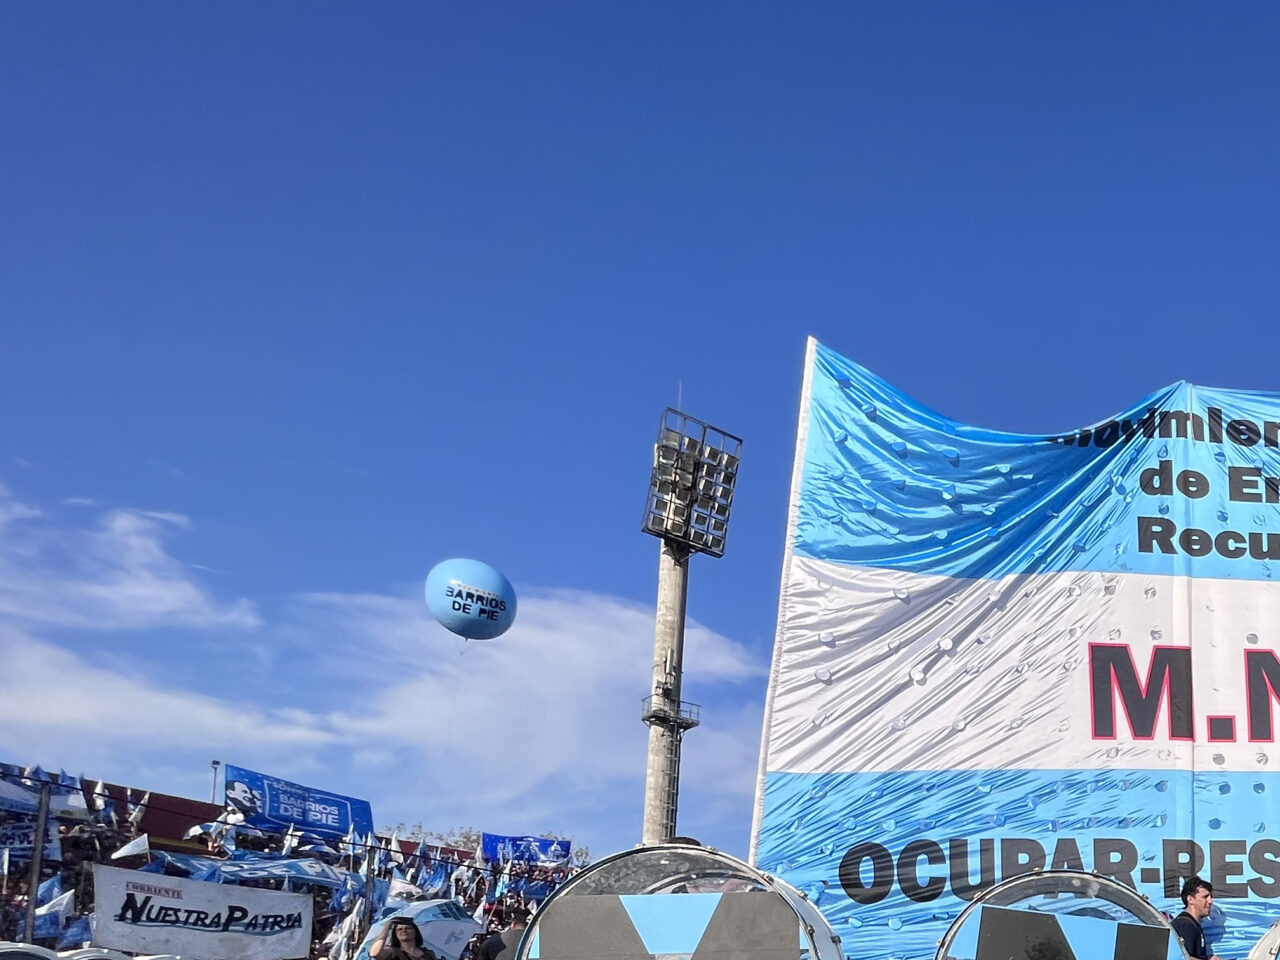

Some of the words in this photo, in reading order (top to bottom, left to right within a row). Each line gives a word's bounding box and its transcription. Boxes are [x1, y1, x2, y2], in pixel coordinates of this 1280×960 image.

[1138, 460, 1210, 500] de
[445, 587, 507, 611] BARRIOS
[452, 600, 472, 614] DE
[478, 608, 500, 621] PIE
[279, 793, 340, 815] BARRIOS
[279, 803, 304, 820] DE
[307, 811, 340, 827] PIE
